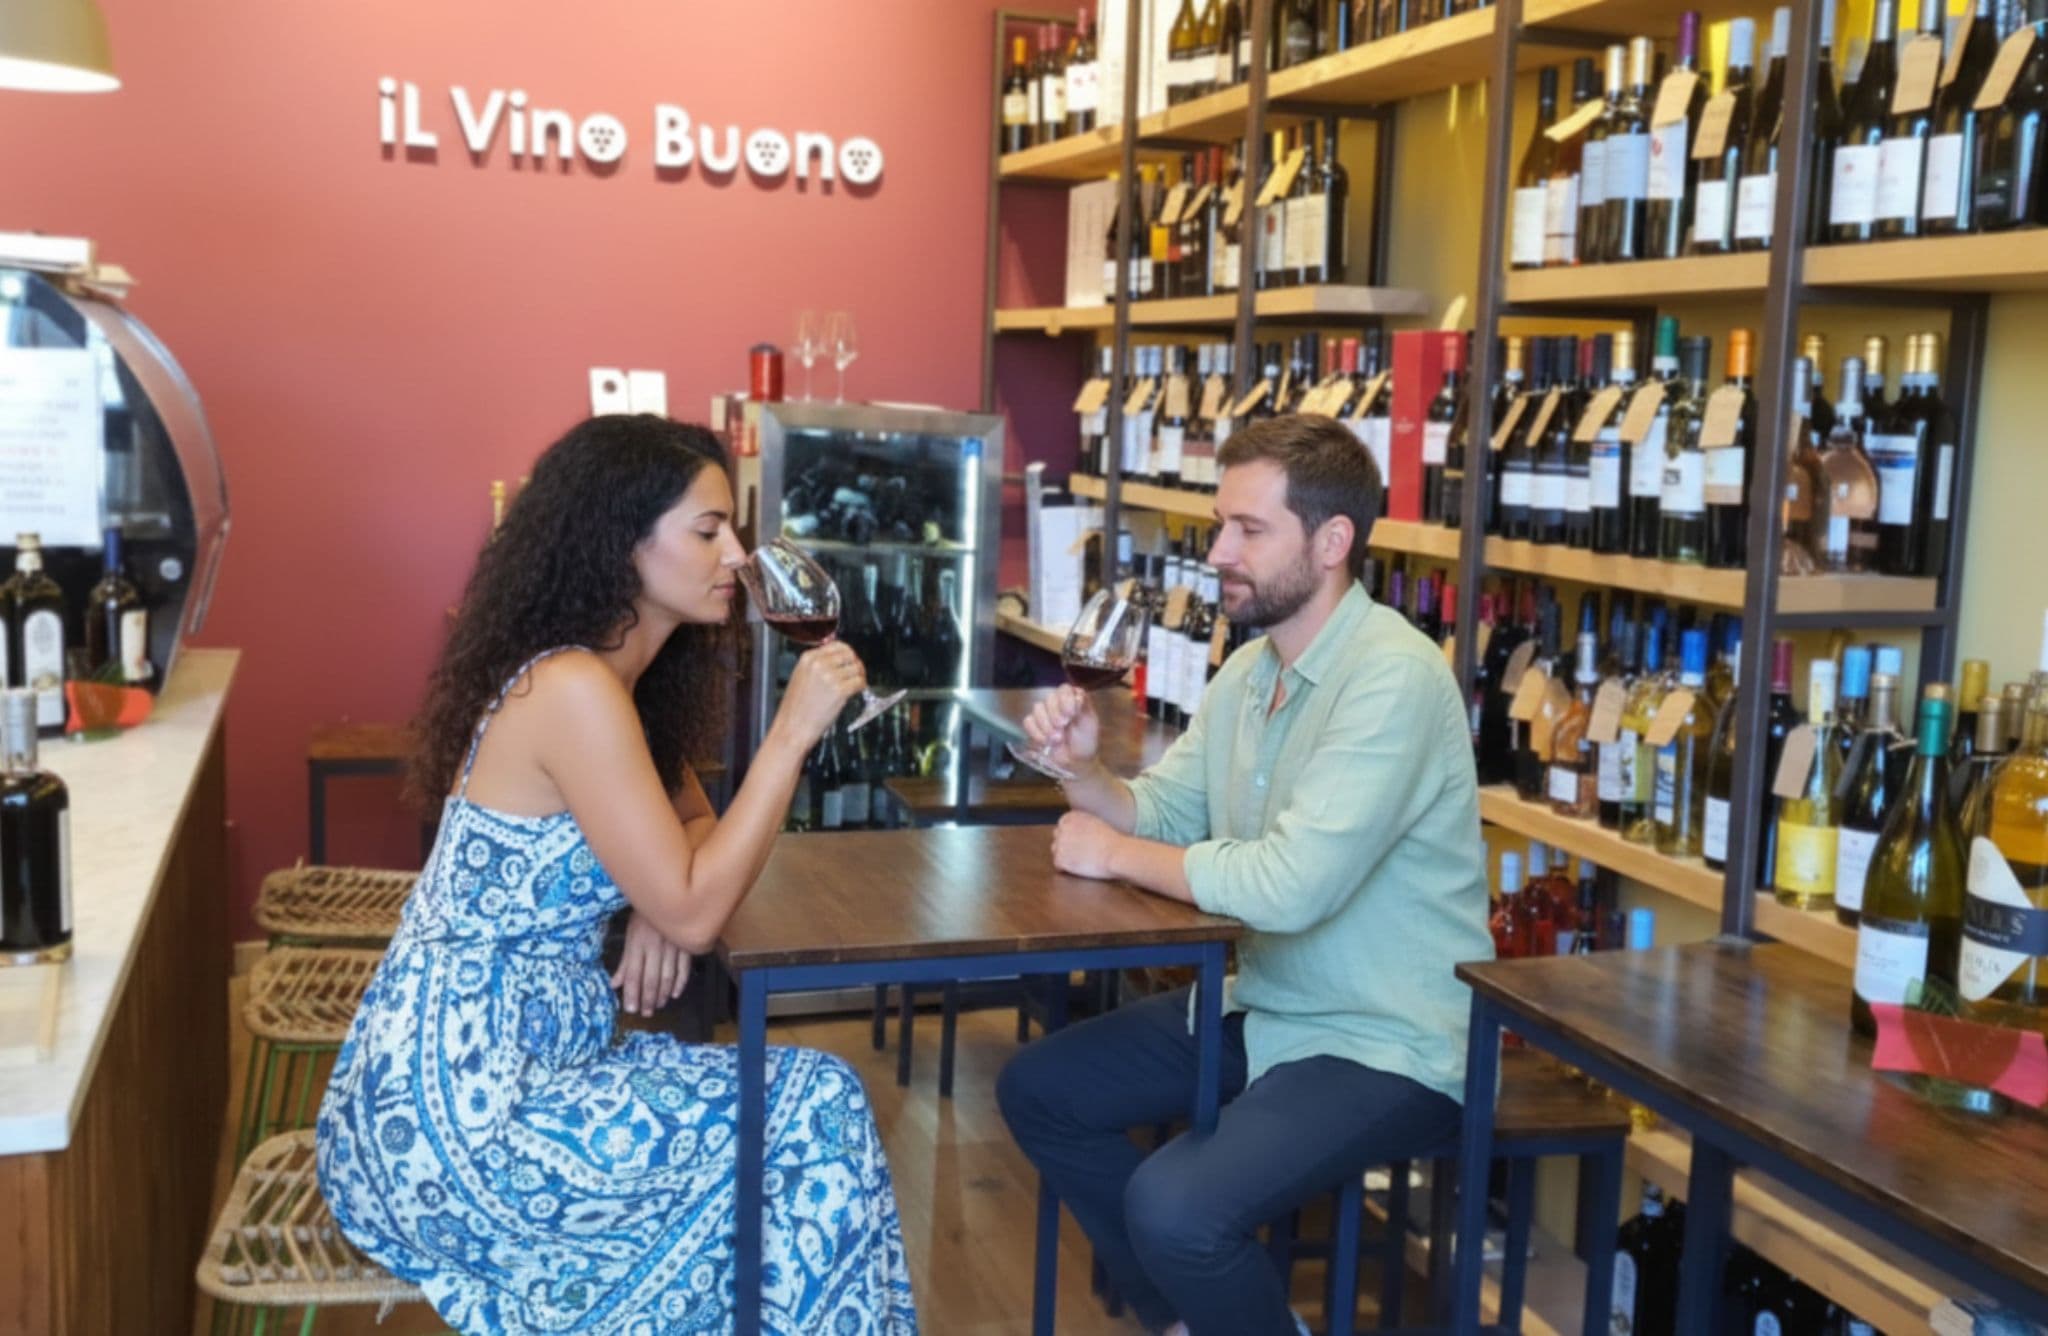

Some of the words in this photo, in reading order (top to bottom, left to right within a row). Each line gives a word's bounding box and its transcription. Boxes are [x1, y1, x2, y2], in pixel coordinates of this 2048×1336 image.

[379, 77, 438, 147] iL
[449, 86, 628, 163] Vino
[654, 104, 884, 185] Buono
